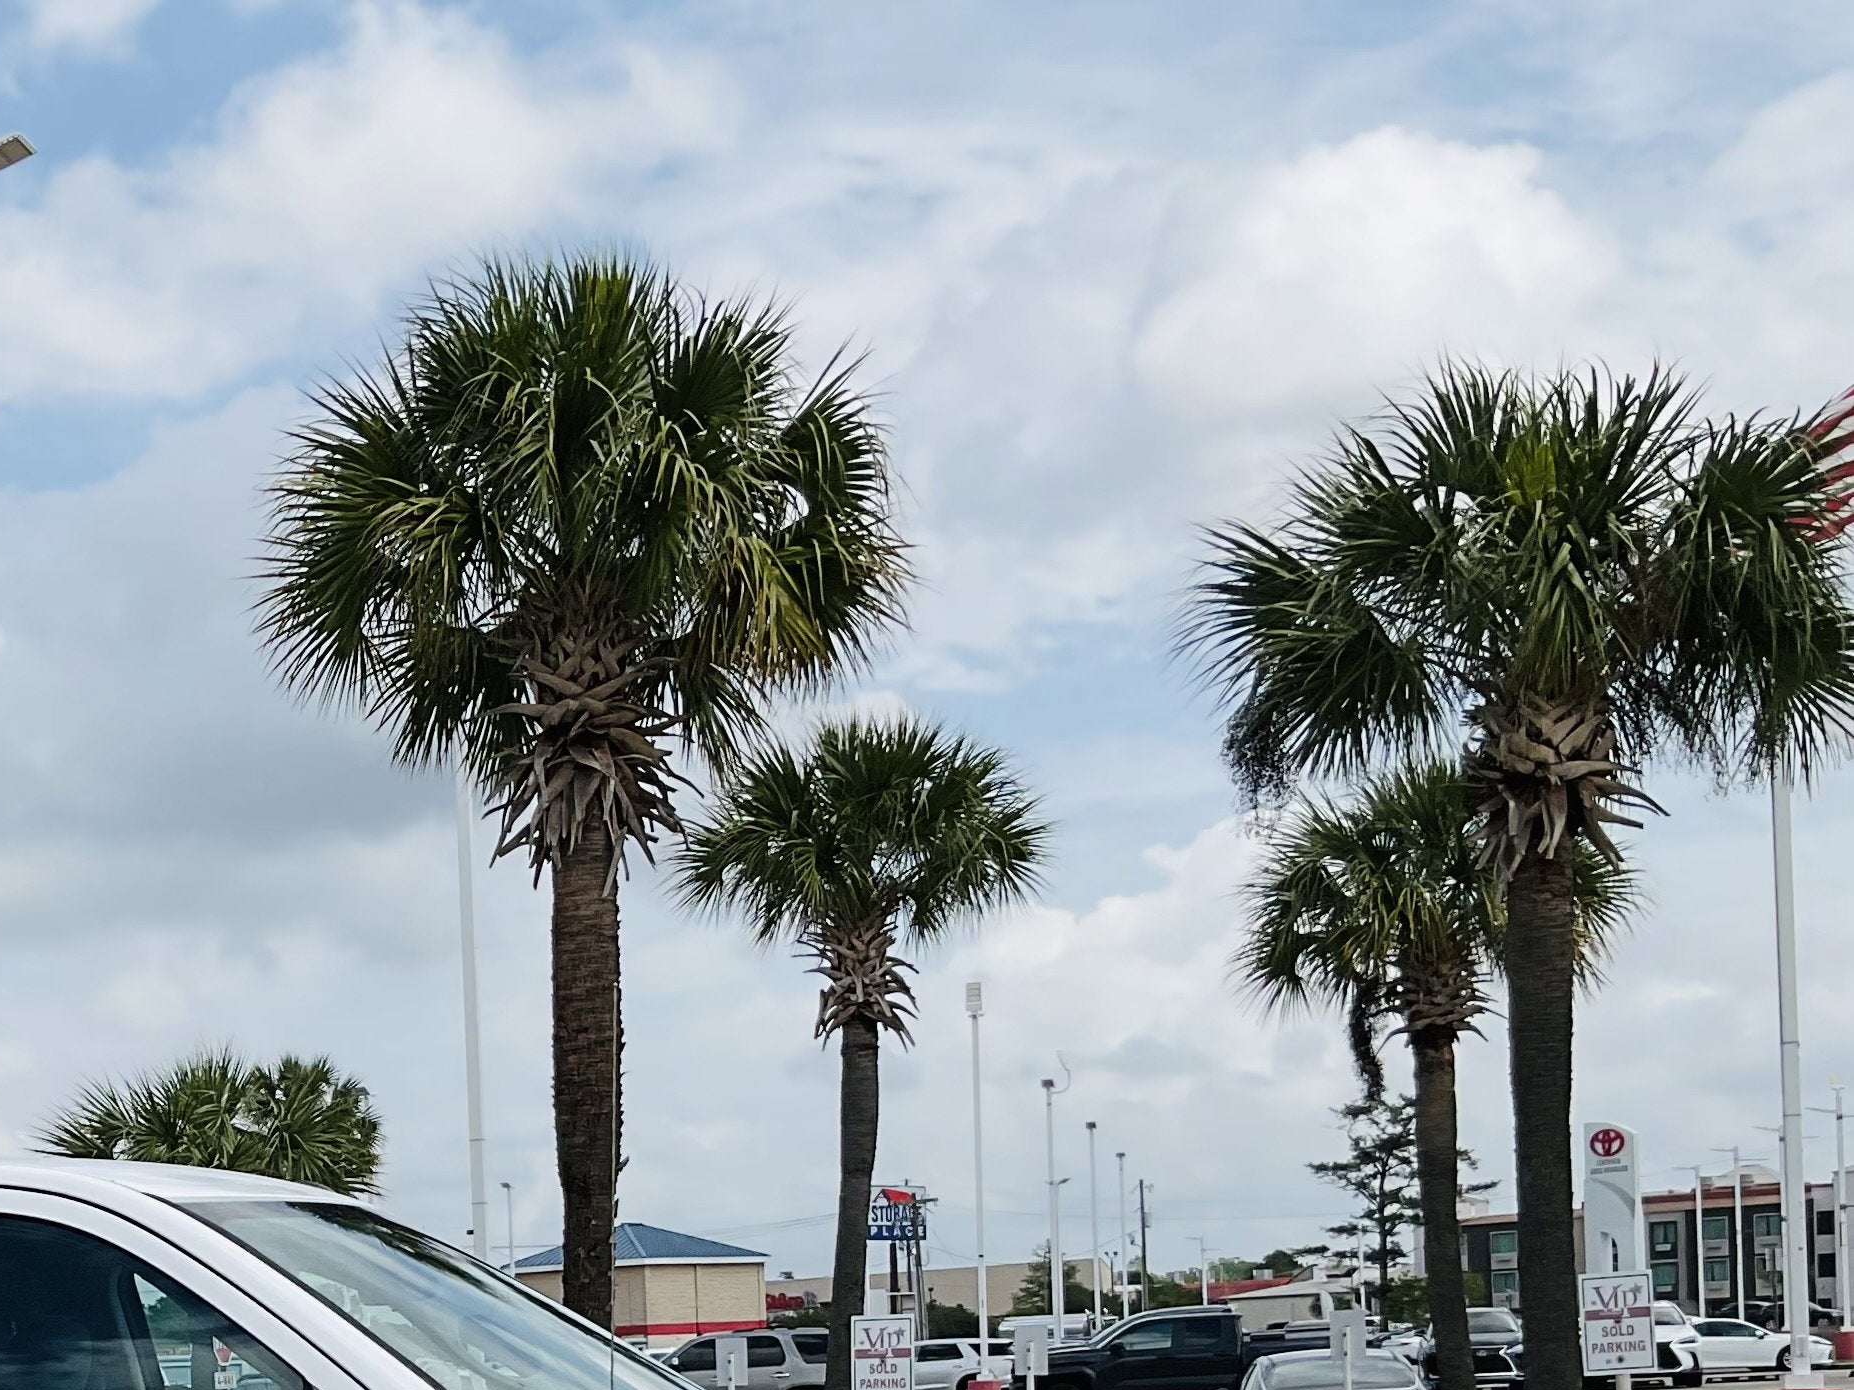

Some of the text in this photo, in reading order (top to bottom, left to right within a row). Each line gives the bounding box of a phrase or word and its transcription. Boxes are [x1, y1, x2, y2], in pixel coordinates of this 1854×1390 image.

[871, 1205, 924, 1223] STORA
[870, 1226, 925, 1237] PLACE
[1601, 1325, 1634, 1337] SOLD
[1591, 1340, 1646, 1354] PARKING
[869, 1363, 897, 1374] SOLD
[859, 1377, 906, 1389] PARKING
